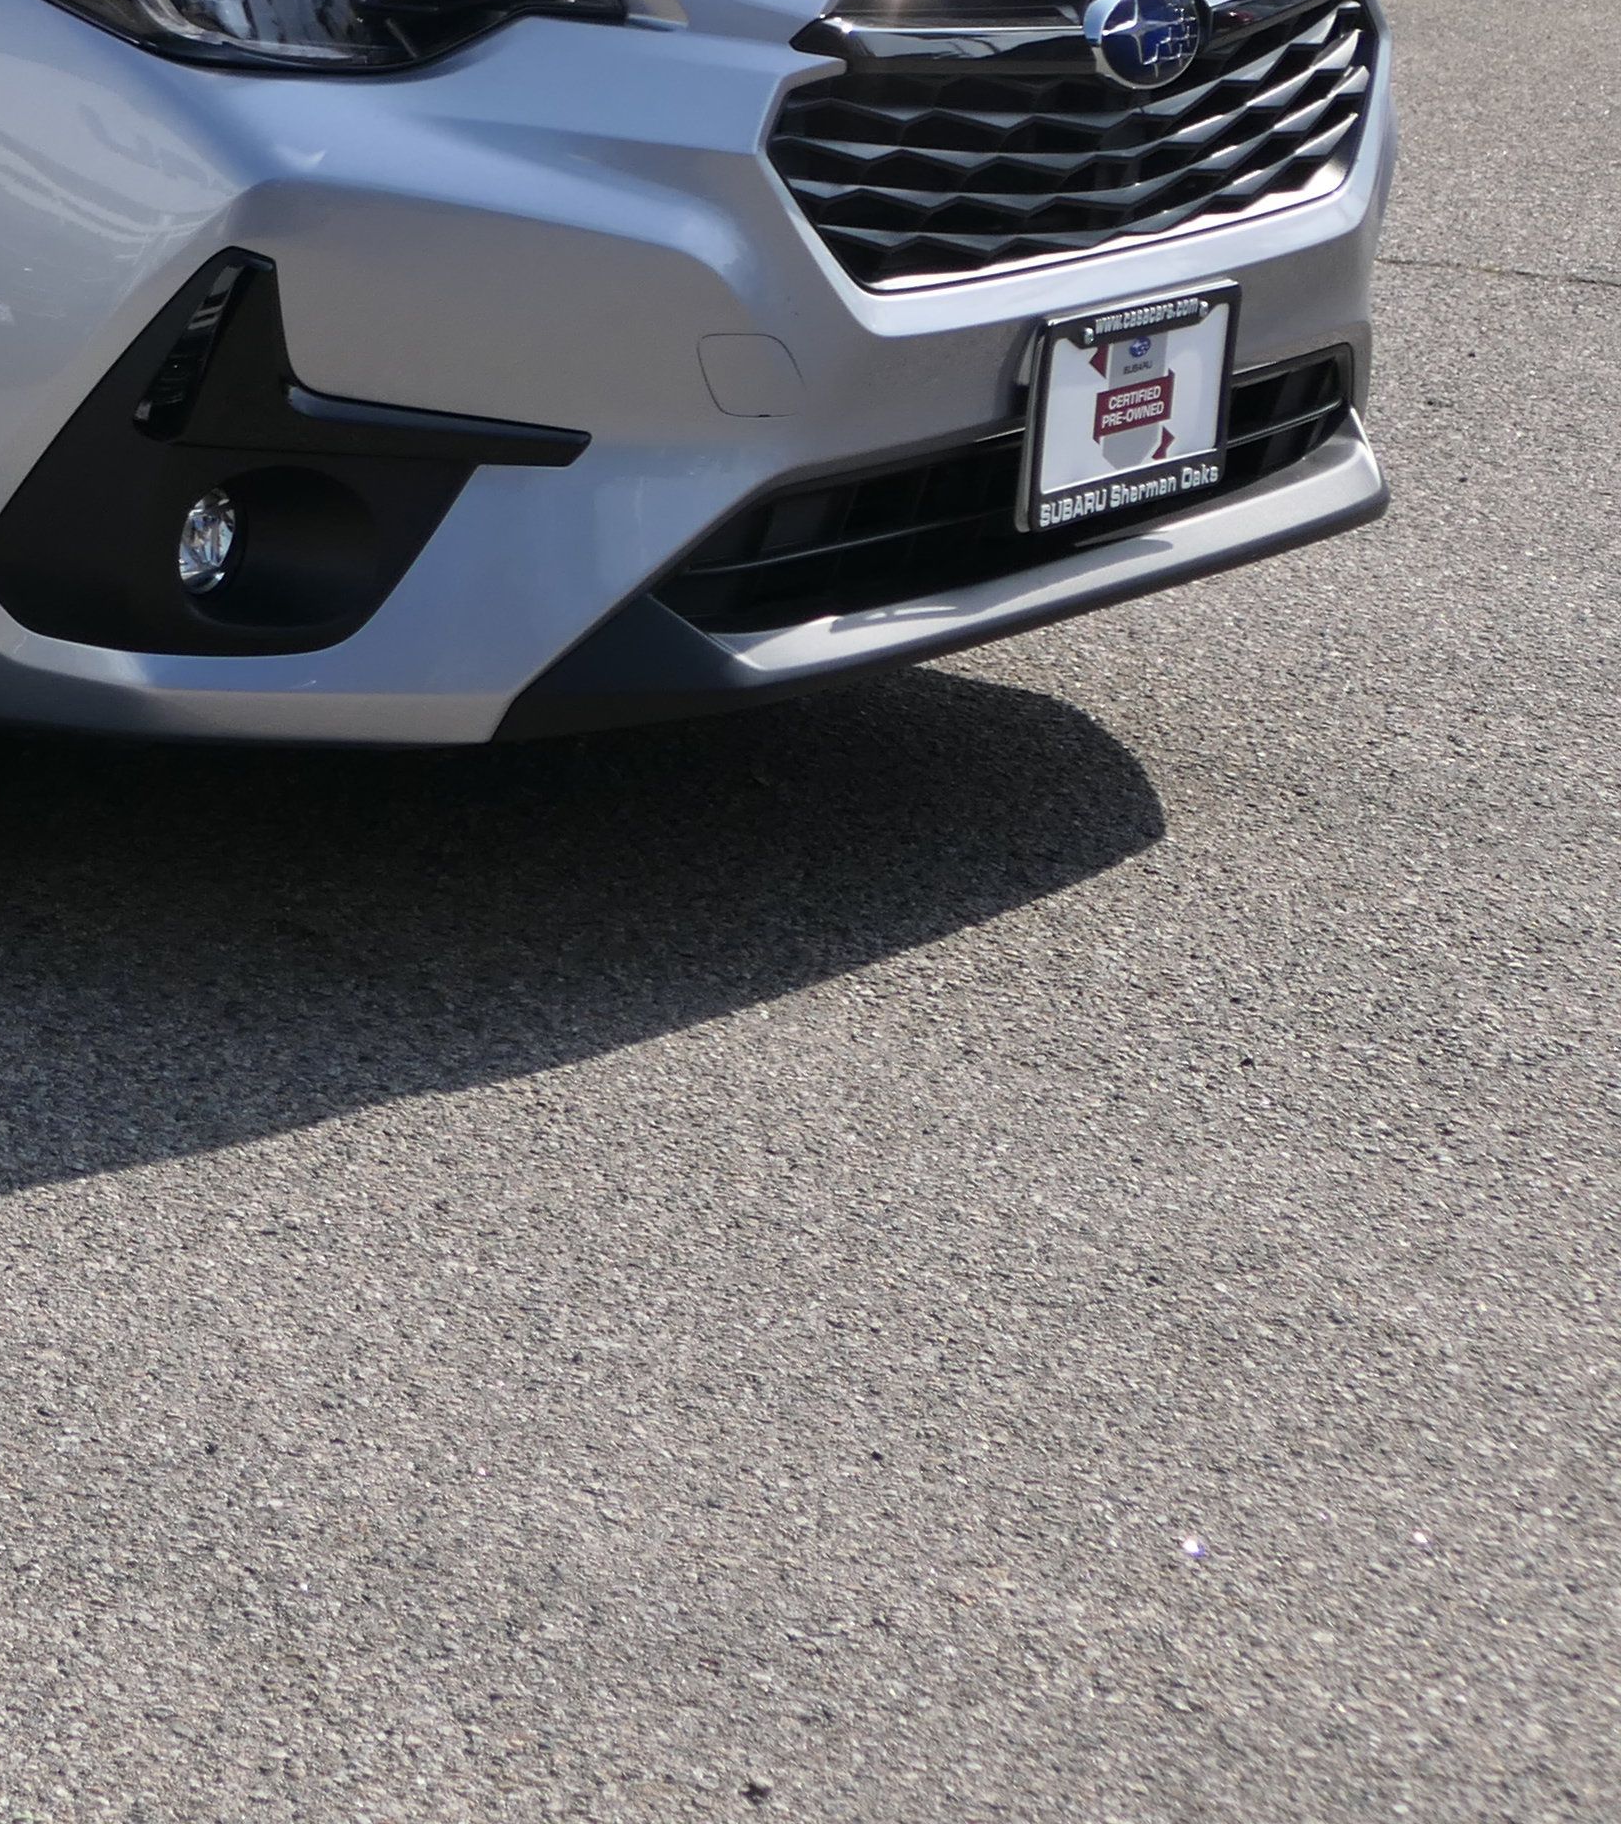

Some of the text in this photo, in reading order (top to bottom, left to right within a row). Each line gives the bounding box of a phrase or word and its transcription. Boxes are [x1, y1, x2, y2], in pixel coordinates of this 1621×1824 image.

[1095, 297, 1199, 335] www.casacars.com
[1123, 360, 1153, 375] SUBARU
[1108, 385, 1161, 411] CERTIFIED
[1101, 401, 1165, 428] PRE-OWNED
[1040, 464, 1219, 527] SUBARU Sherman Oaks
